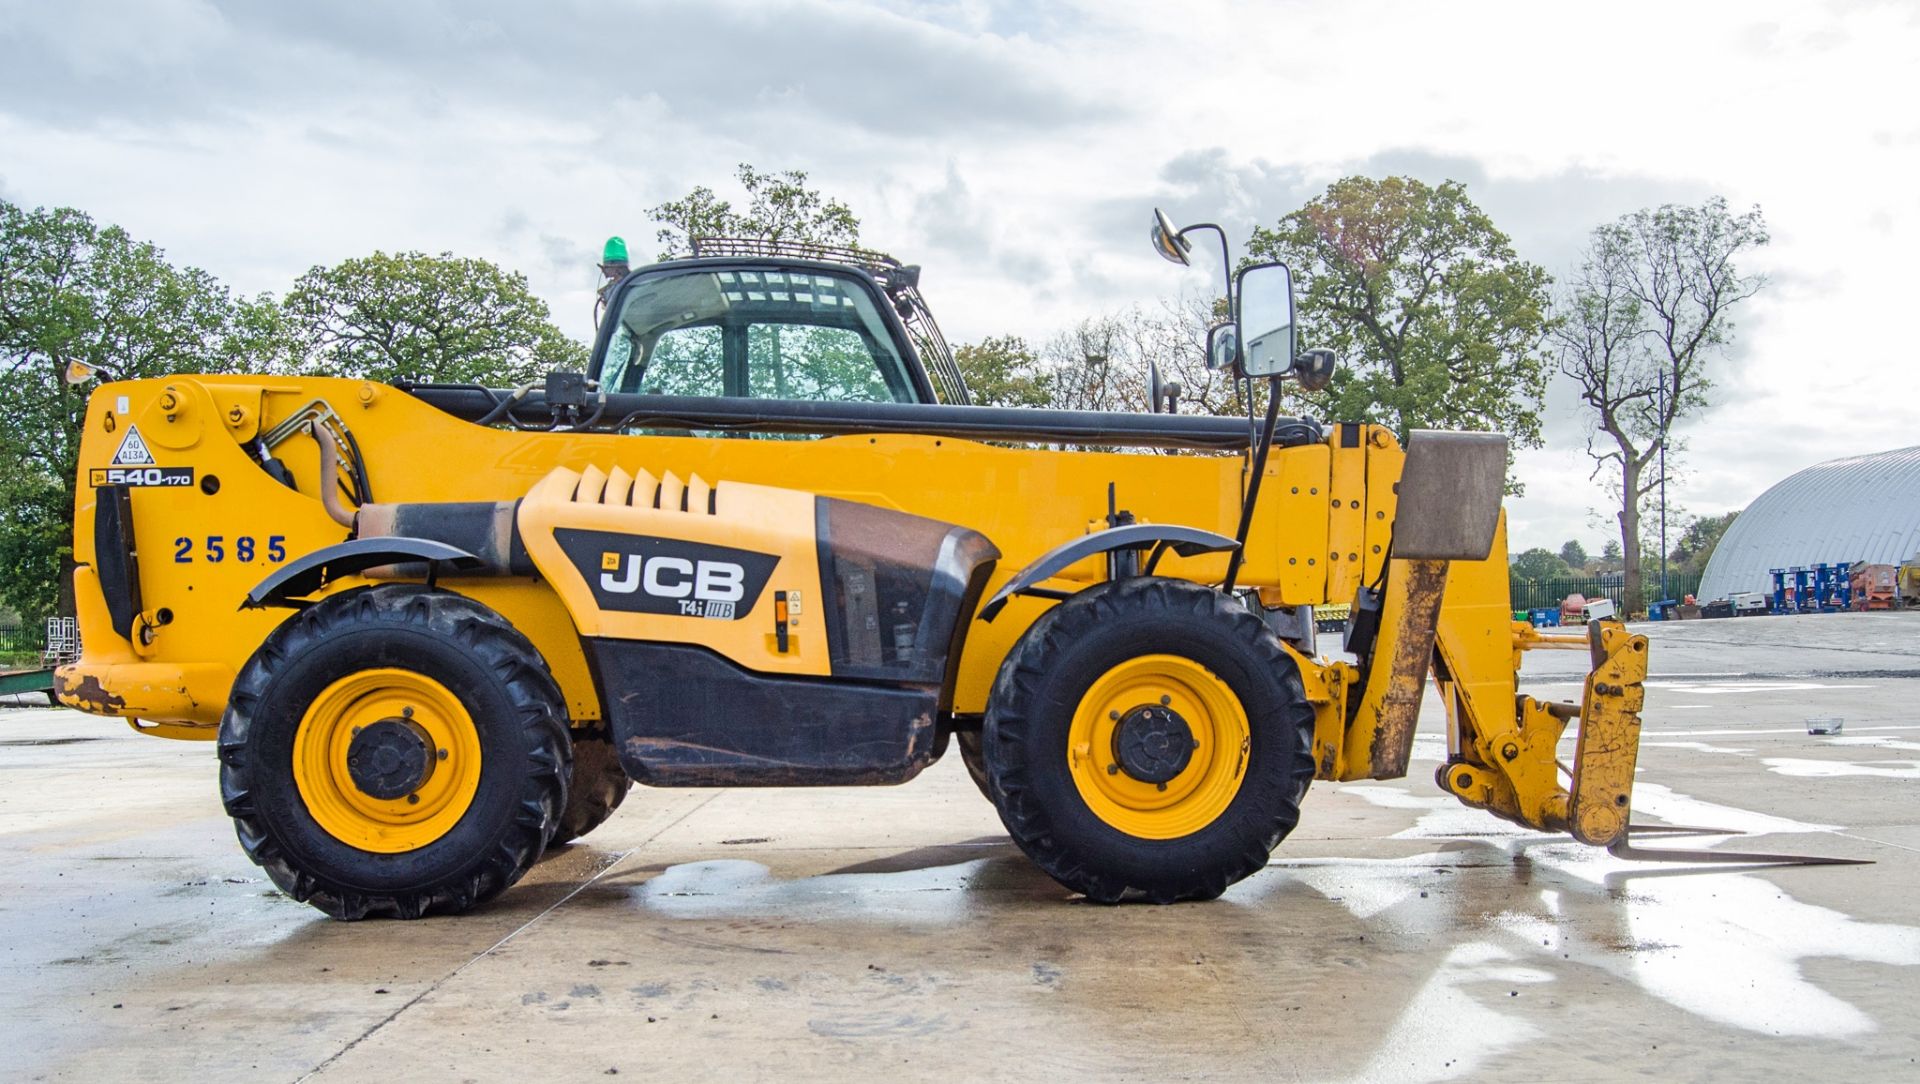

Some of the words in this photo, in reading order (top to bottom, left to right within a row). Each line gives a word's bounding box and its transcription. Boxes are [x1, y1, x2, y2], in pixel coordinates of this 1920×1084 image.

[108, 469, 190, 485] 540-170
[600, 554, 745, 602] JCB
[678, 599, 703, 616] T4i
